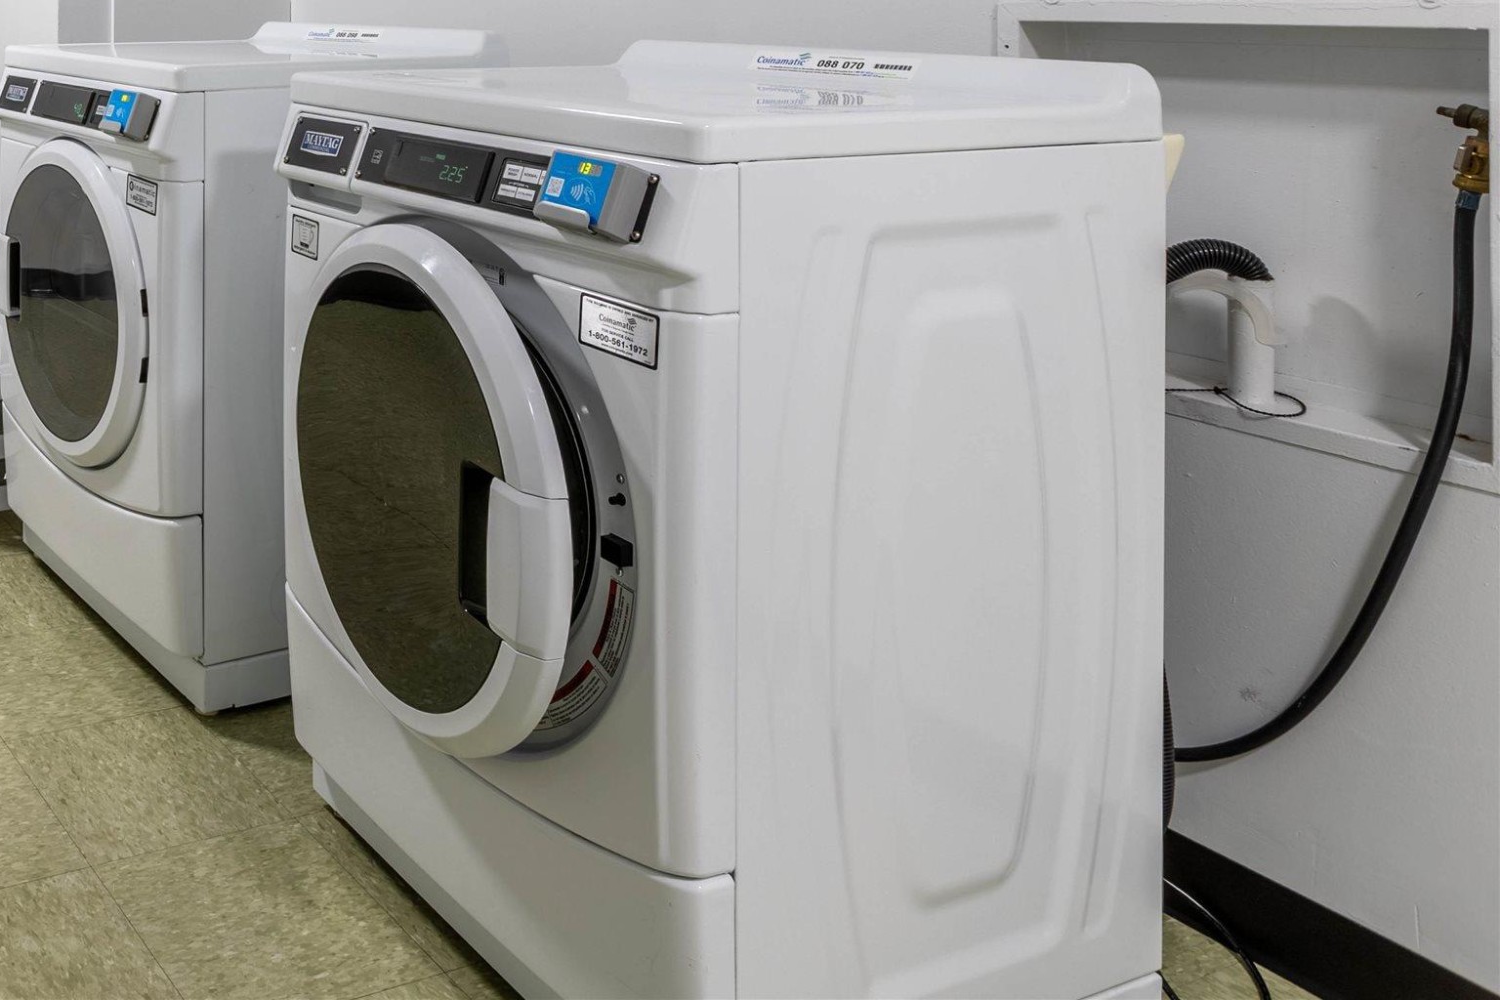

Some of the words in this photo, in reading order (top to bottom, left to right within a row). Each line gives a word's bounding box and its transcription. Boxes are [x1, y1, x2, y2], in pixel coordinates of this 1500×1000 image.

[756, 55, 806, 67] Coinamatic
[816, 59, 839, 69] 088
[842, 61, 865, 71] 070
[304, 133, 340, 149] MAYTAG
[579, 162, 592, 175] 13
[598, 313, 635, 332] Coinamatic
[588, 329, 648, 357] 1-800-561-1972
